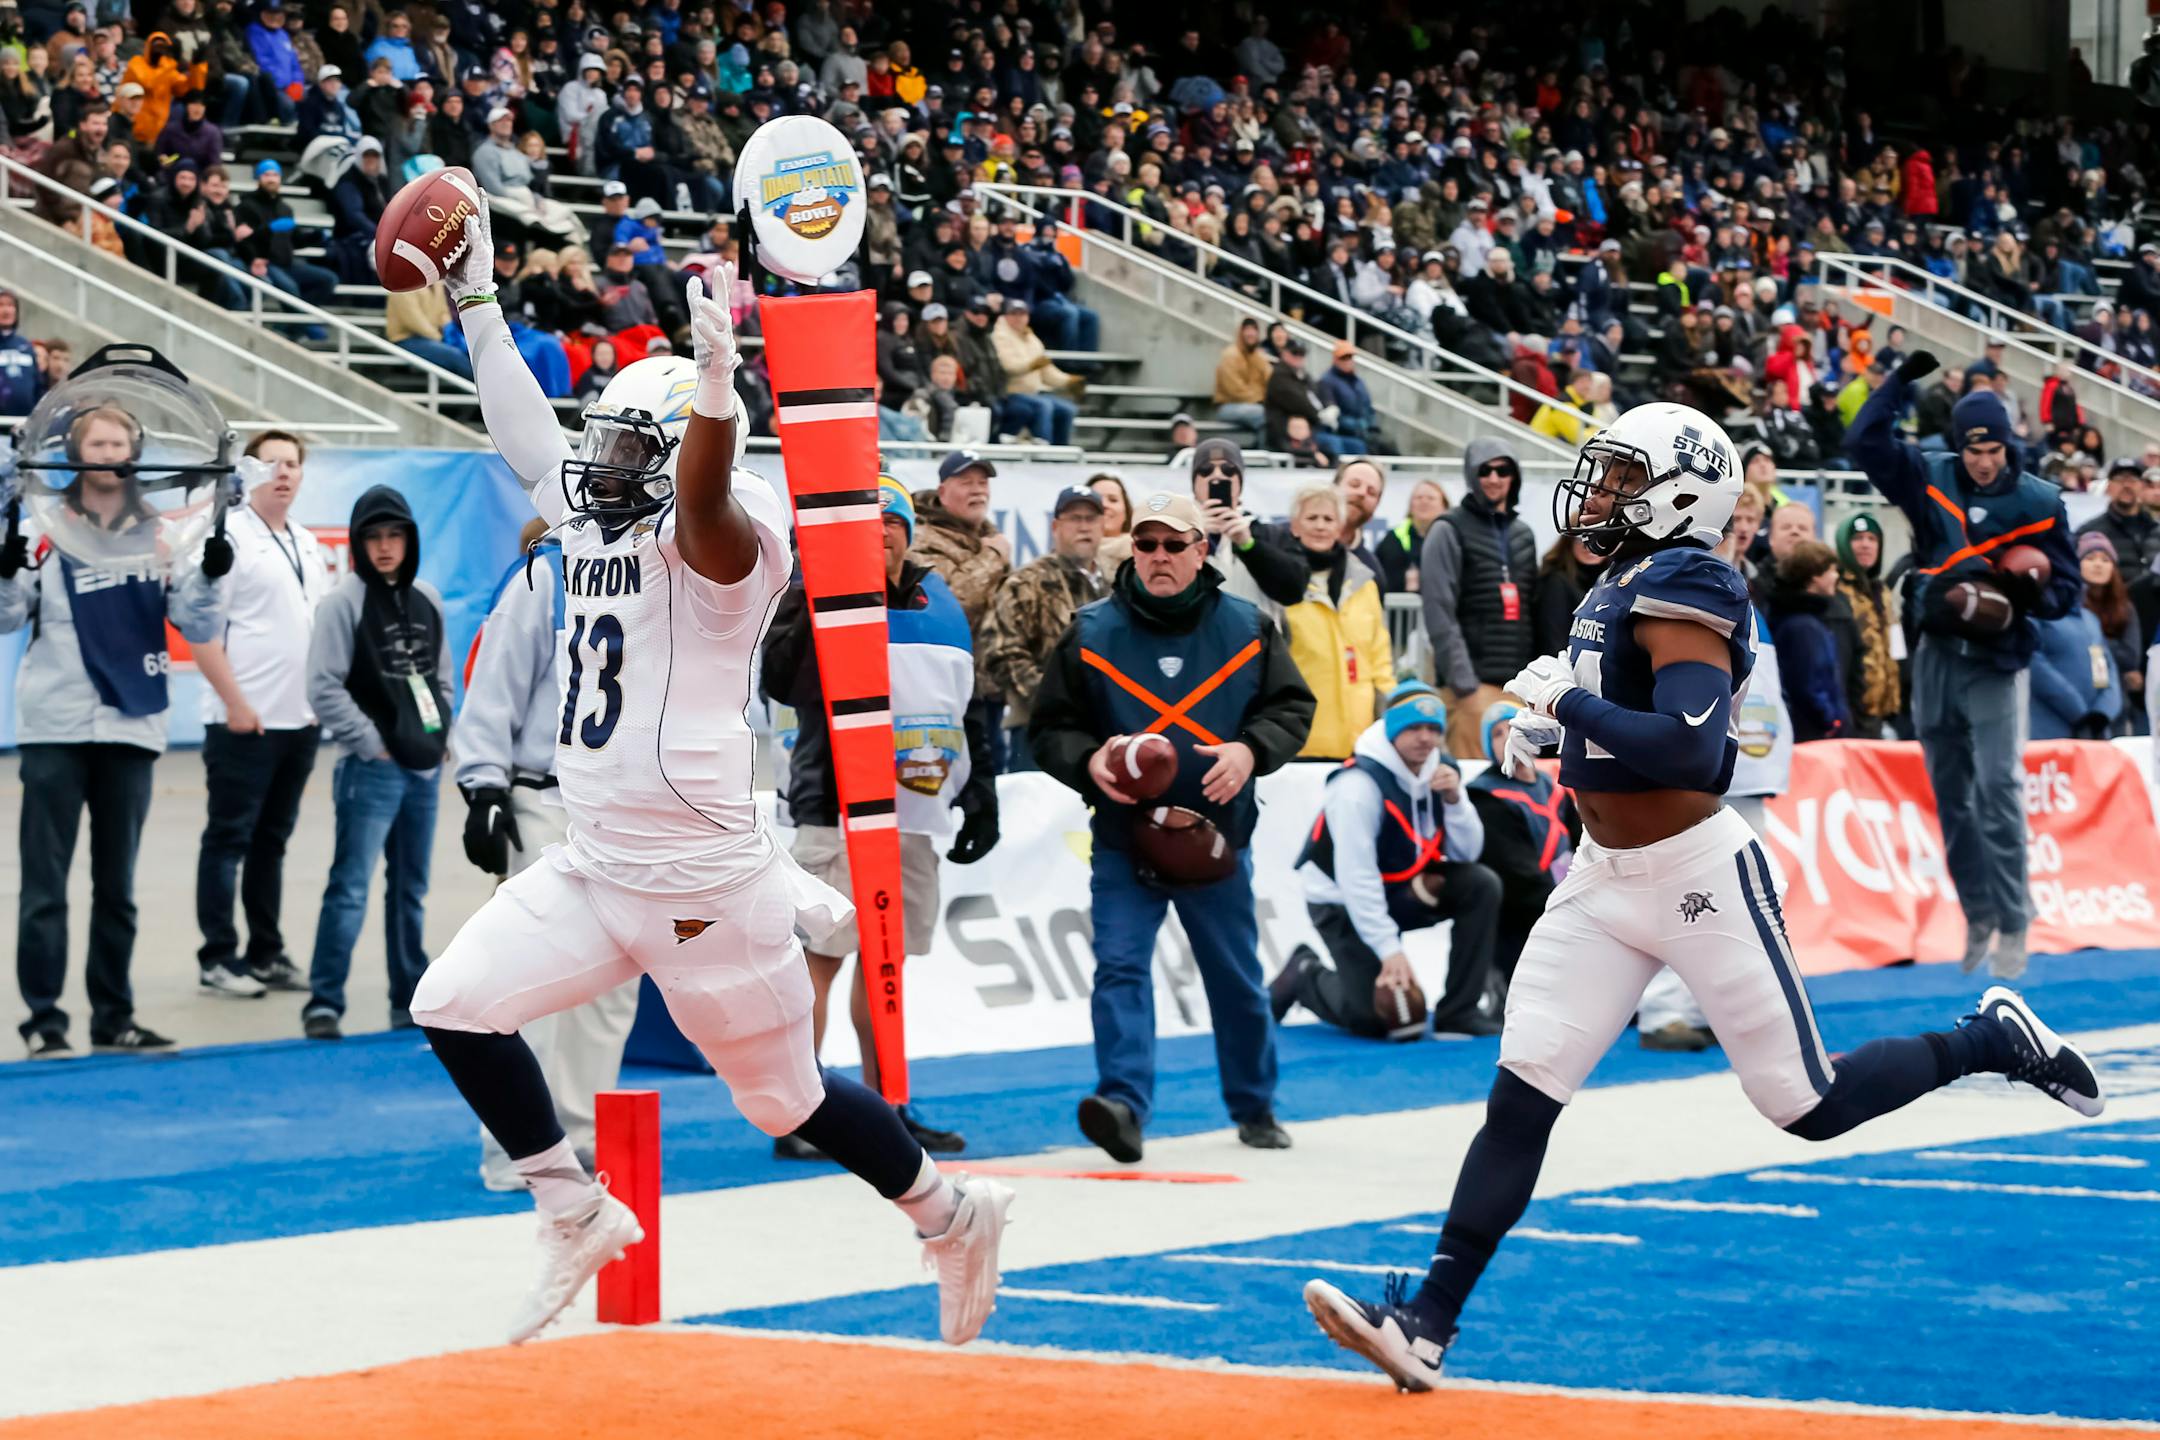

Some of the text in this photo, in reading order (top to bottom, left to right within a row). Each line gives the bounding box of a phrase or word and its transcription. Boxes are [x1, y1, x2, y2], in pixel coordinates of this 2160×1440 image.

[429, 200, 471, 248] Wilson
[790, 205, 839, 224] BOWL
[1673, 435, 1728, 476] STATE
[559, 614, 625, 750] 13
[2023, 760, 2078, 816] et's
[1764, 789, 1961, 906] YOTA
[2030, 877, 2158, 930] Places
[874, 889, 897, 1015] Gilman
